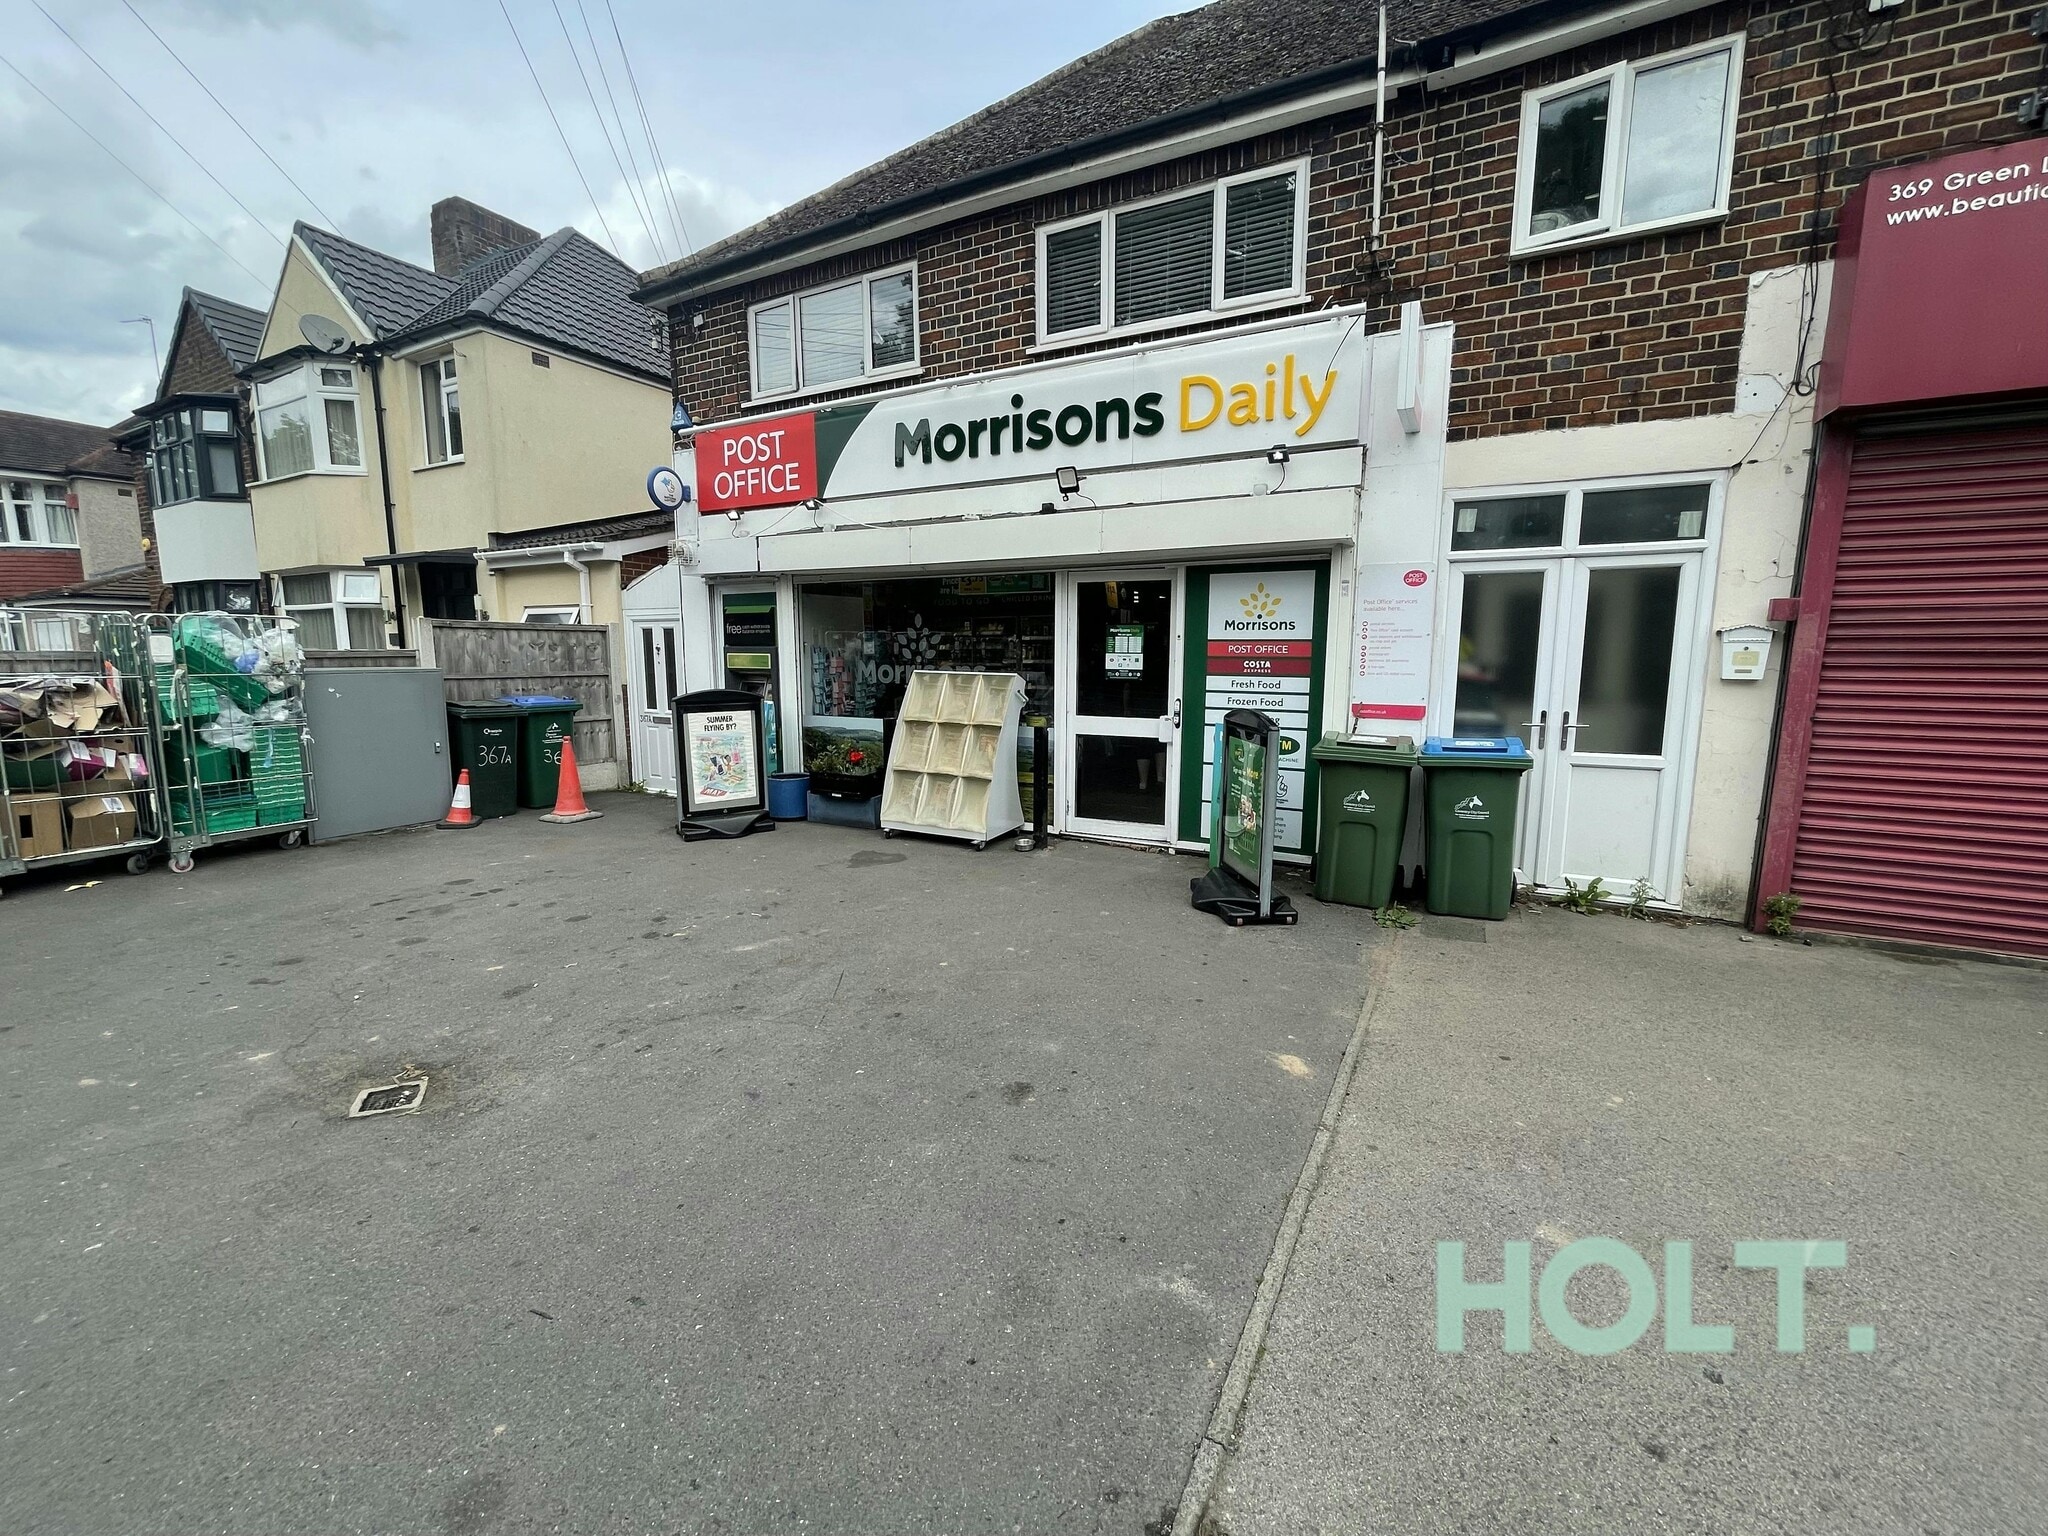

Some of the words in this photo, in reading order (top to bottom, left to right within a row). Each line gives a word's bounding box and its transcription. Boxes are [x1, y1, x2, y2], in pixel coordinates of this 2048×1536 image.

[1888, 179, 1933, 202] 369
[1943, 163, 2030, 191] Green
[894, 392, 1165, 468] Morrisons
[1180, 354, 1338, 436] Daily
[723, 430, 785, 466] POST
[713, 462, 800, 499] OFFICE
[726, 622, 742, 634] free
[1224, 614, 1296, 631] Morrisons
[1228, 645, 1252, 653] POST
[1254, 645, 1288, 654] OFFICE
[1243, 660, 1271, 668] COSTA
[1231, 680, 1255, 688] Fresh
[1257, 680, 1281, 689] Food
[1227, 697, 1257, 705] Frozen
[1260, 698, 1284, 707] Food
[706, 715, 733, 724] SUMMER
[704, 724, 724, 732] FLYING
[726, 723, 737, 731] BY?
[478, 745, 512, 767] 367A
[543, 749, 562, 765] 36
